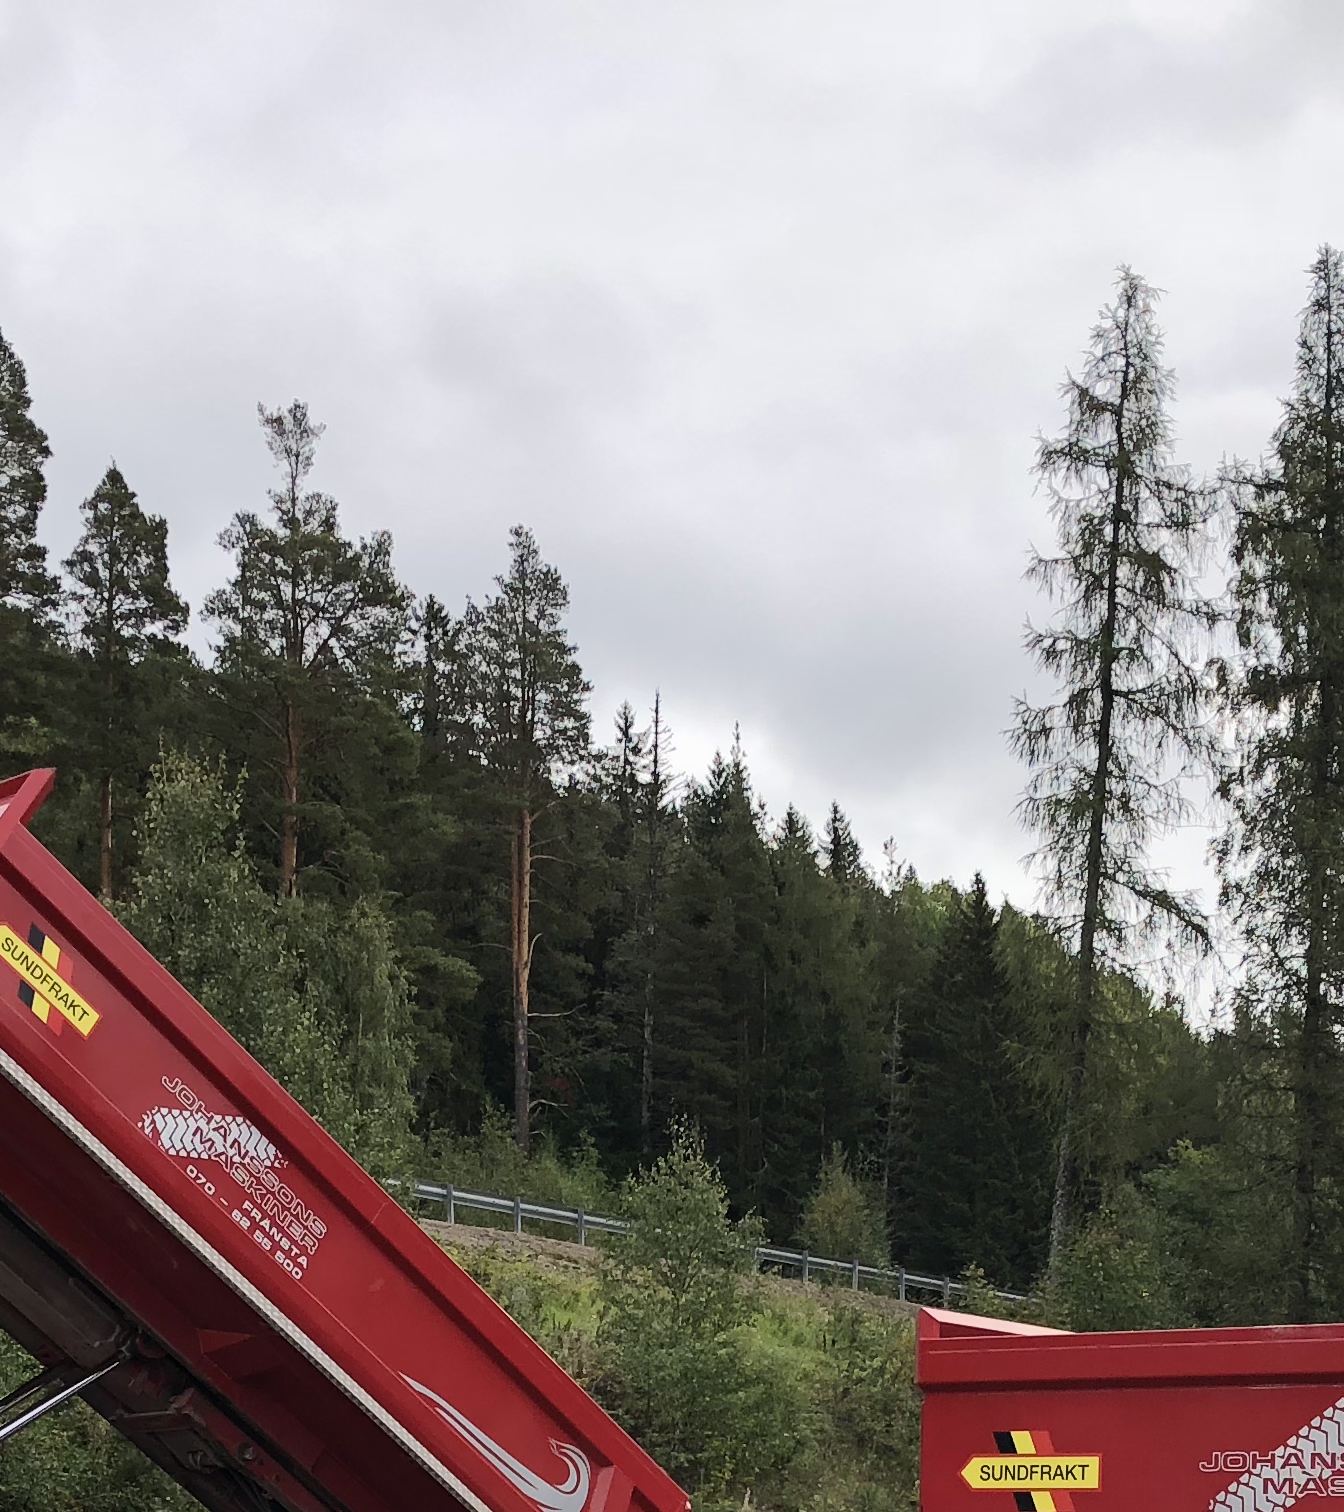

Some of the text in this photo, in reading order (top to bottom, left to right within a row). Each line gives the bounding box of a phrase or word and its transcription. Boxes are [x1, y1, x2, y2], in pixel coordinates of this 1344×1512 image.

[1, 937, 89, 1022] SUNDFRAKT
[162, 1076, 327, 1239] JOHANSSONS
[192, 1126, 319, 1255] MASKINER
[186, 1164, 216, 1196] 070
[231, 1209, 251, 1231] 62
[253, 1229, 273, 1251] 55
[274, 1250, 303, 1280] 500
[979, 1464, 1090, 1482] SUNDFRAKT
